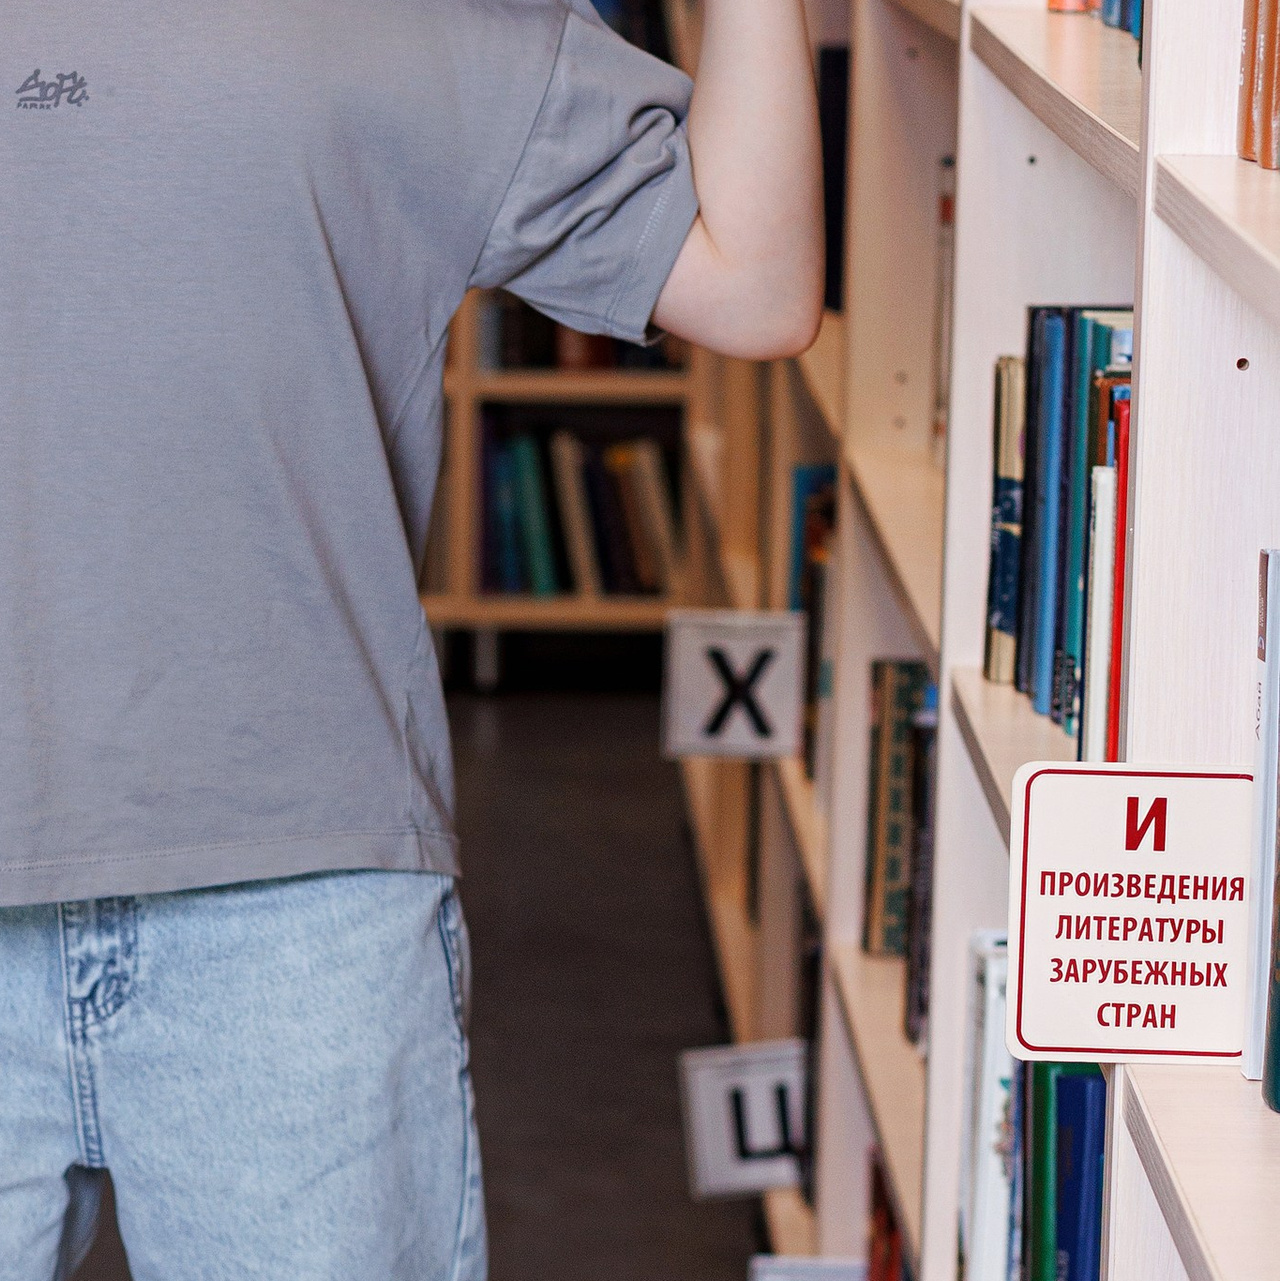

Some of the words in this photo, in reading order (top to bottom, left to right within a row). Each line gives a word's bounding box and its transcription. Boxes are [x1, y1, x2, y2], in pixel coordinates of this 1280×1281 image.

[705, 641, 776, 739] Х
[1124, 796, 1168, 852] И
[1038, 870, 1245, 904] ПРОИЗВЕДЕНИЯ
[1054, 914, 1225, 944] ЛИТЕРАТУРЫ
[1049, 957, 1229, 988] ЗАРУБЕЖНЫХ
[1096, 1002, 1177, 1029] СТРАН
